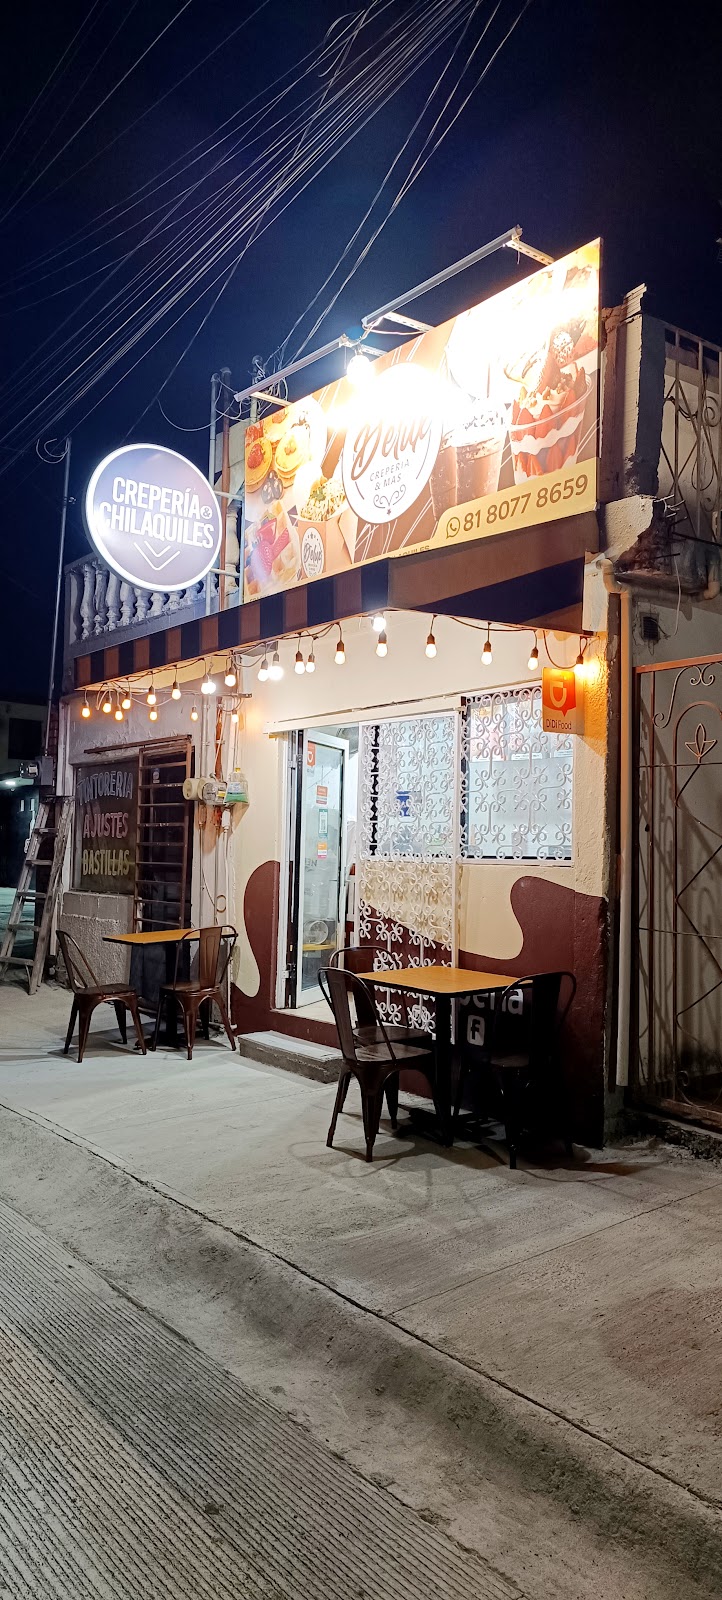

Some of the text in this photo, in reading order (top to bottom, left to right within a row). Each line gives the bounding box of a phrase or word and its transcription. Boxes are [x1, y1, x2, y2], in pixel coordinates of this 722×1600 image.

[369, 458, 410, 482] CREPERIA
[374, 472, 402, 491] & MAS
[111, 475, 212, 520] CREPERÍA &
[463, 474, 589, 532] 81 8077 8659
[97, 501, 215, 550] CHILAQUILES
[77, 770, 134, 806] TINTORERIA
[83, 811, 129, 839] AJUSTES
[82, 849, 130, 876] BASTILLAS
